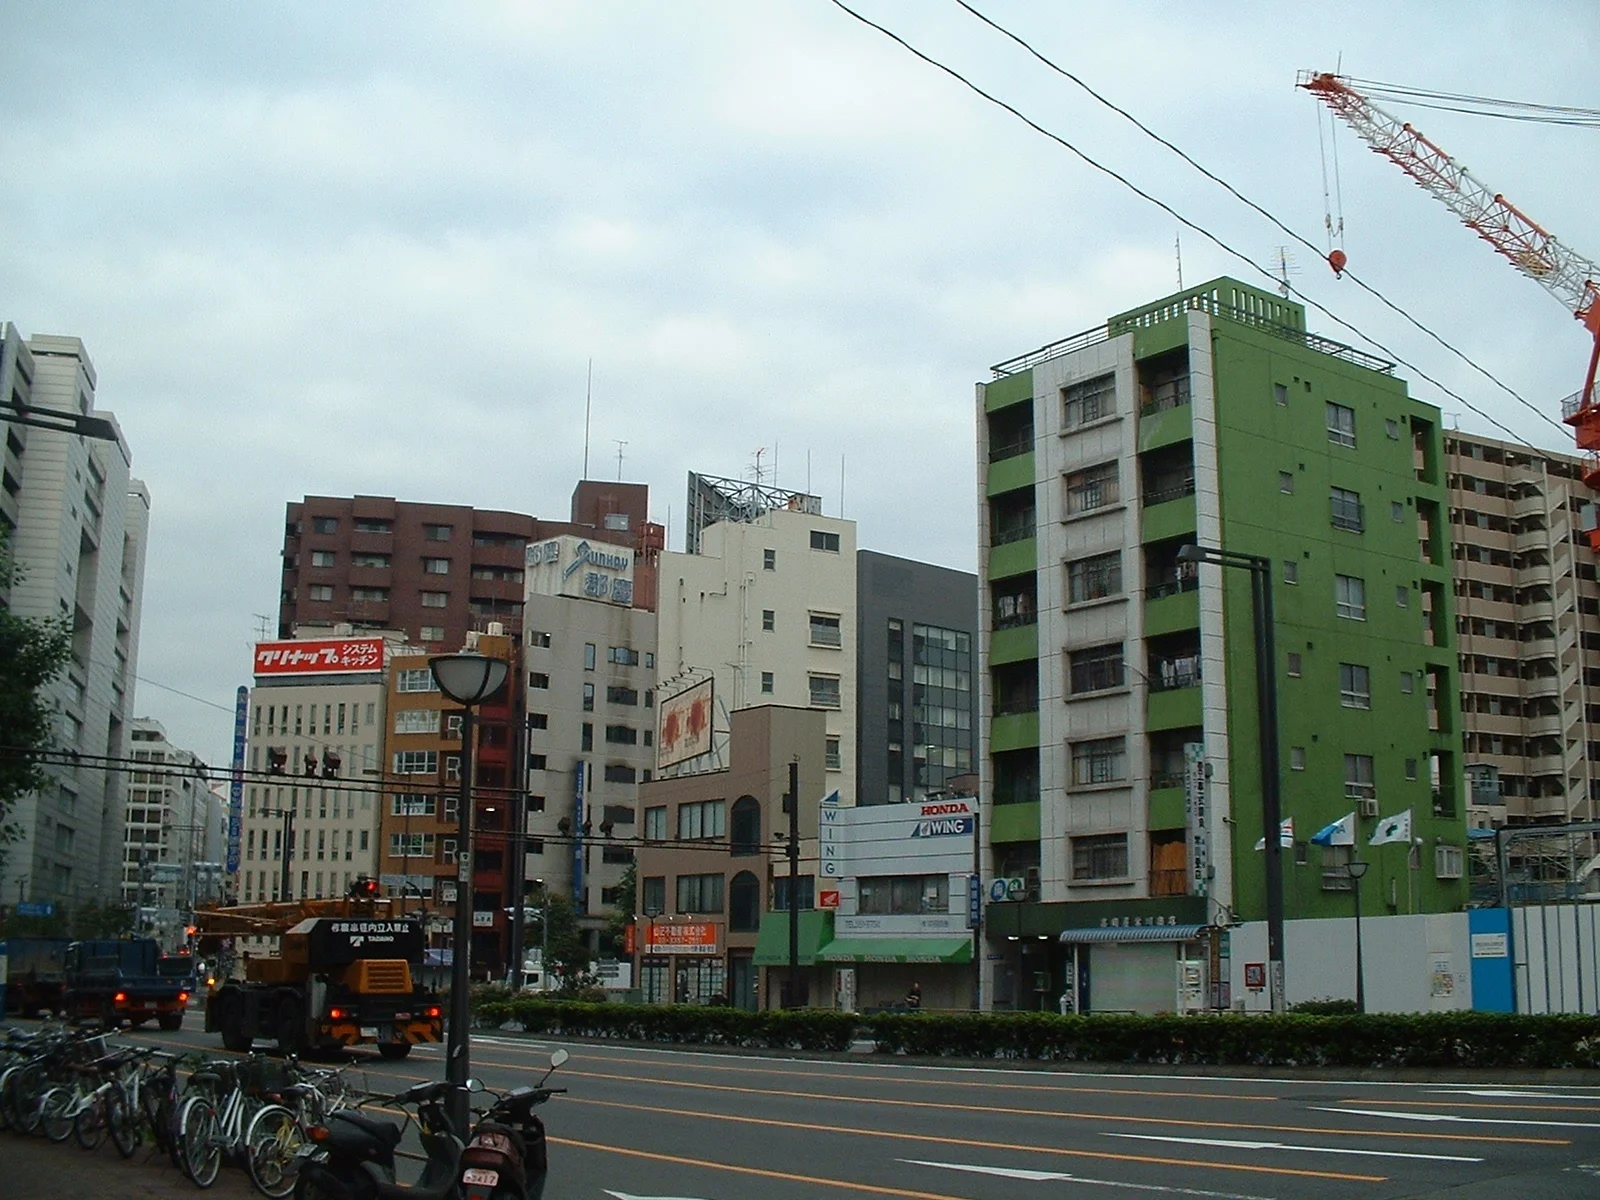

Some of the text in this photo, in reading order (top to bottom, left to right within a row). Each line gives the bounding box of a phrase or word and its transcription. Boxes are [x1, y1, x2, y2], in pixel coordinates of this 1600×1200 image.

[342, 643, 378, 655] システム
[341, 654, 378, 667] キッチン
[921, 803, 969, 816] HONDA
[931, 819, 964, 835] WING
[824, 811, 837, 874] WING
